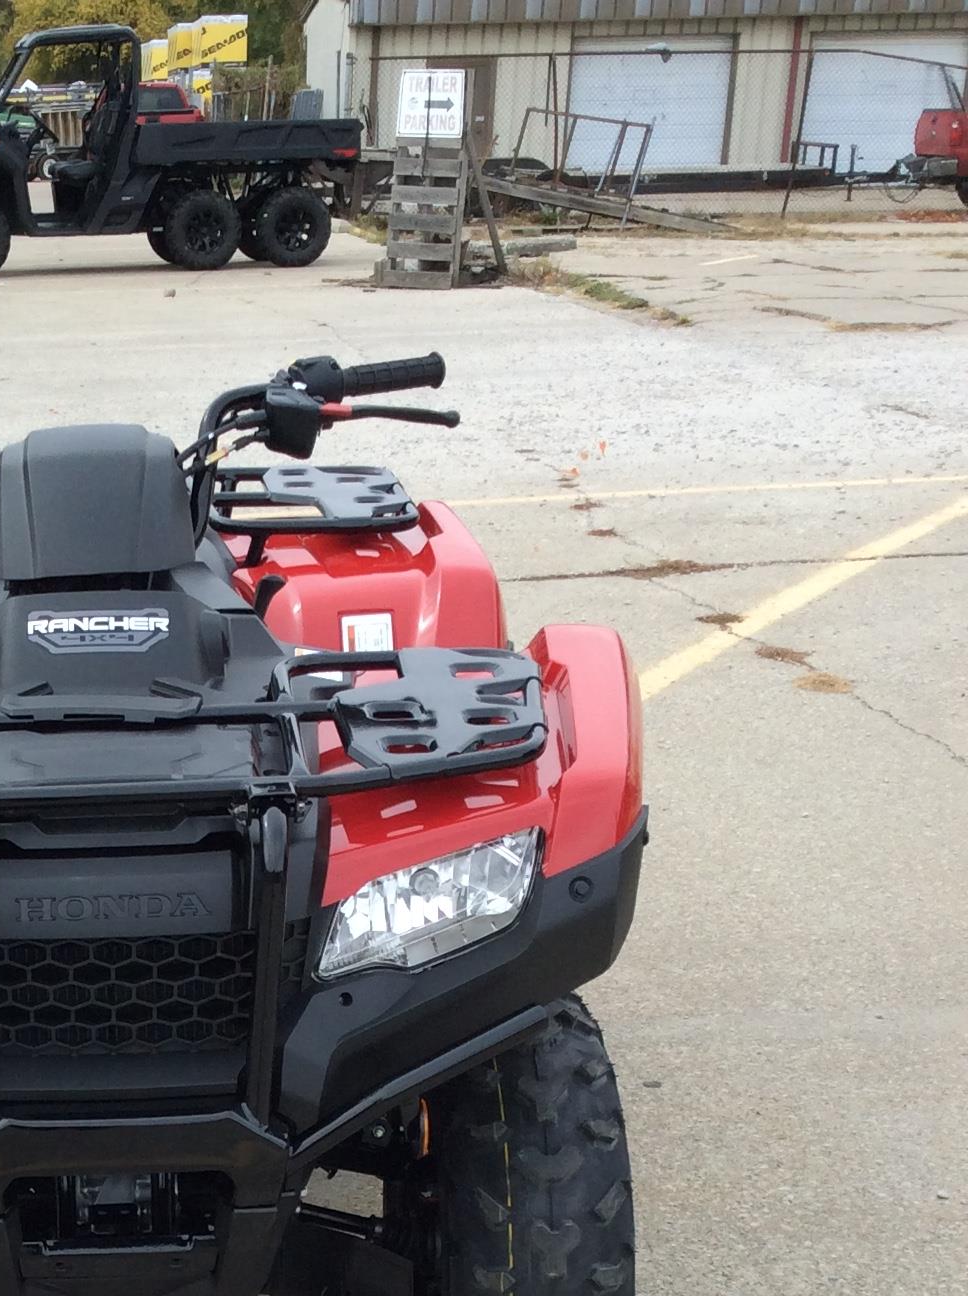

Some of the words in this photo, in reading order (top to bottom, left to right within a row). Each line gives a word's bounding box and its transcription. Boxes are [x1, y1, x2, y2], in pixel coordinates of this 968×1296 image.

[408, 76, 457, 93] TRAILER
[404, 114, 456, 131] PARKING
[27, 616, 170, 635] RANCHER
[15, 891, 212, 923] HONDA
